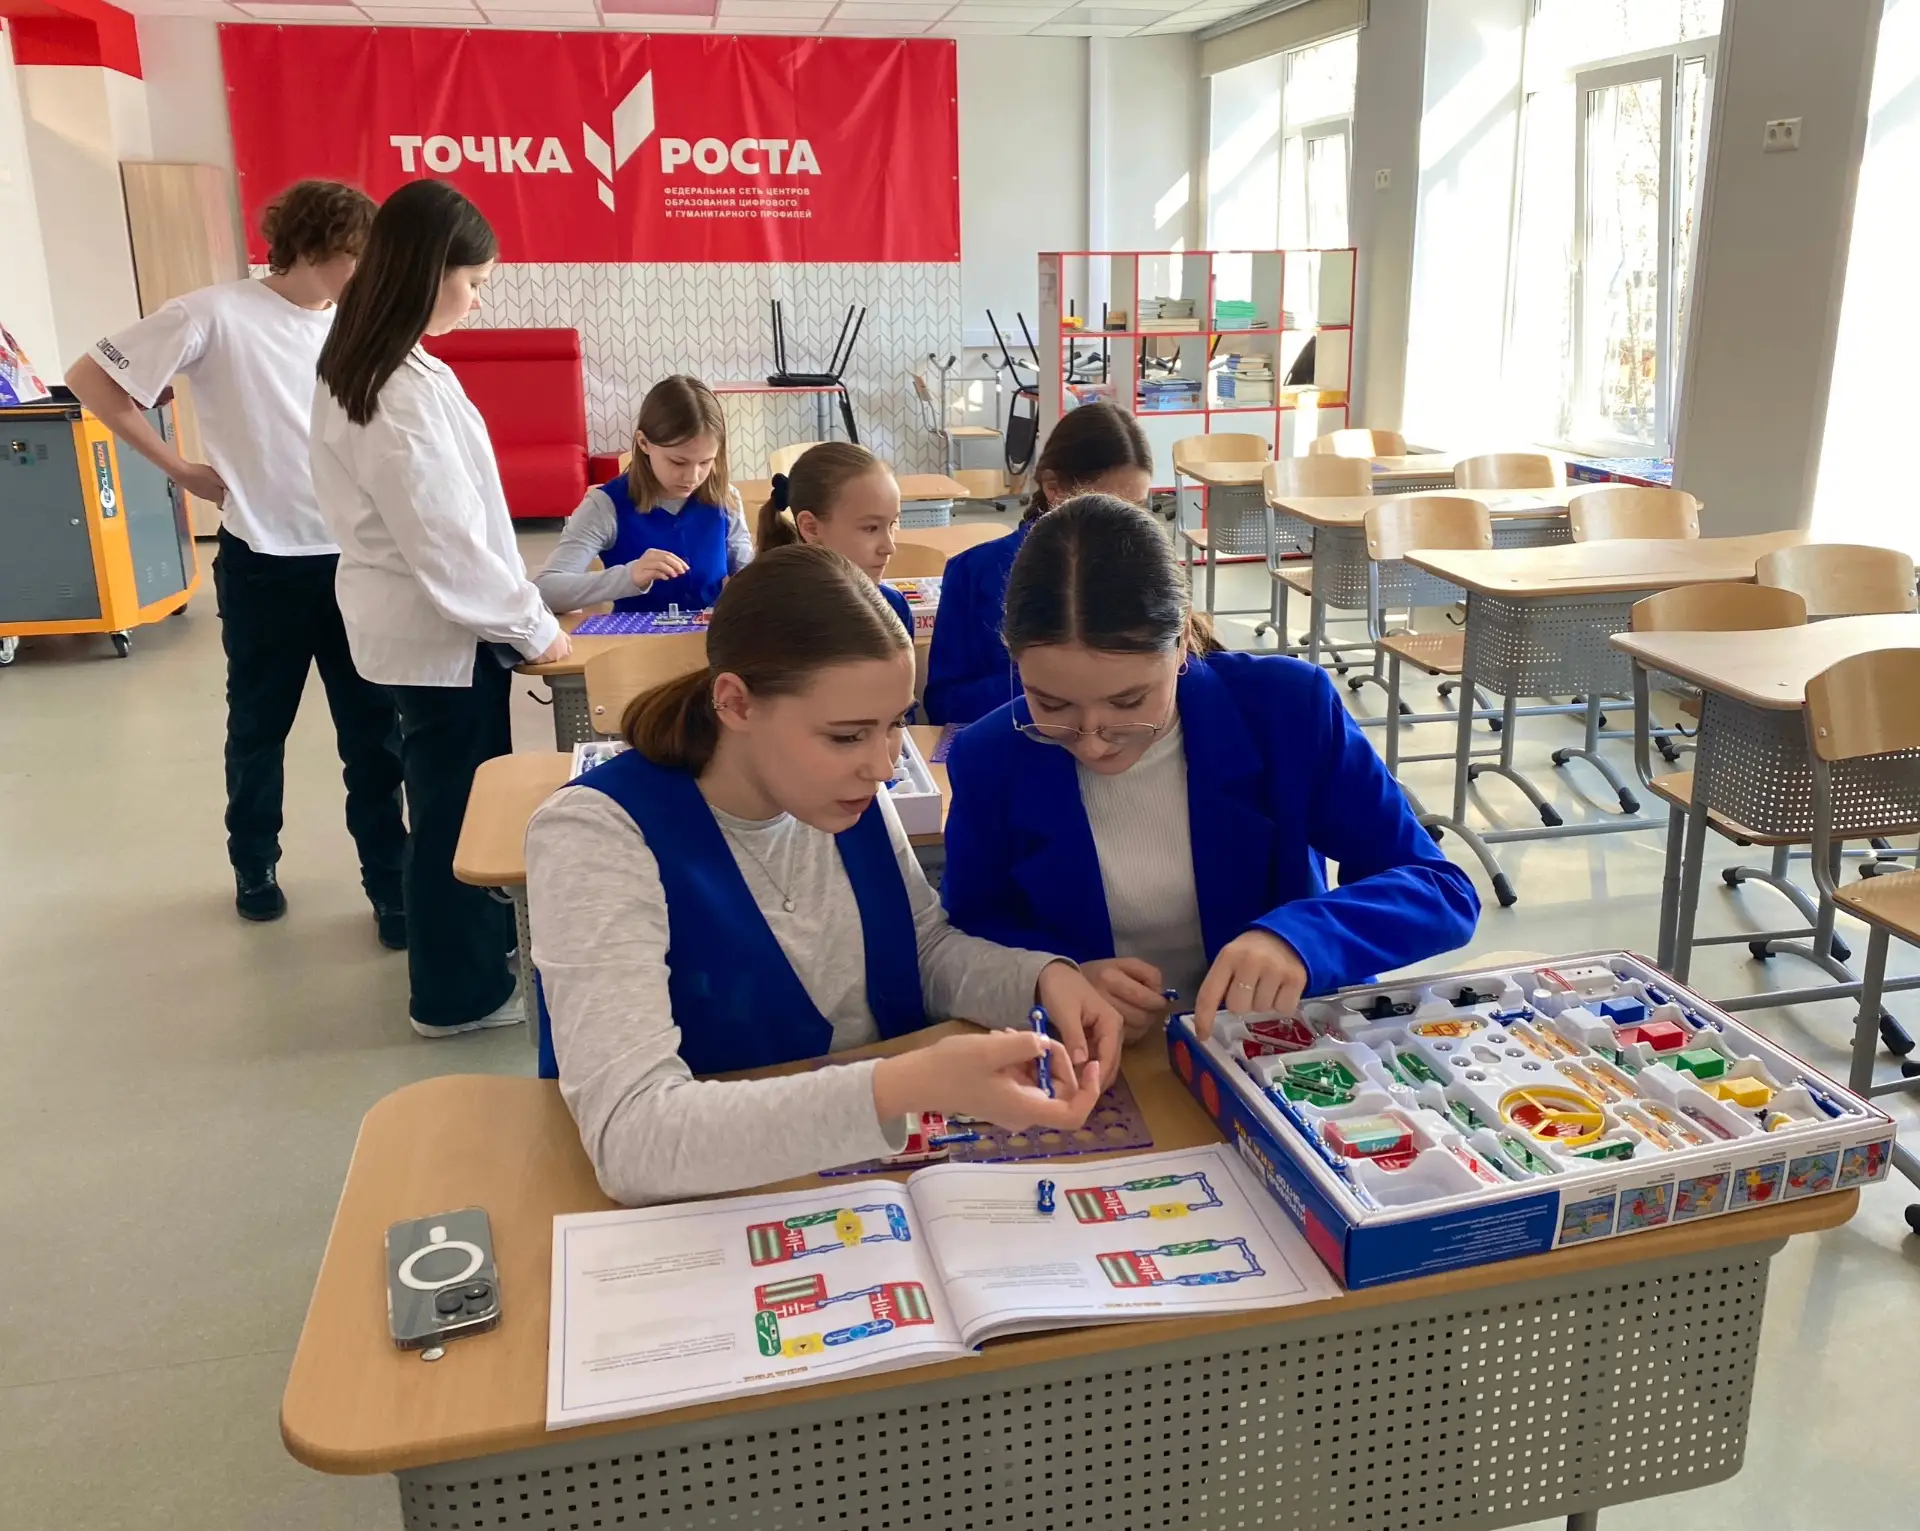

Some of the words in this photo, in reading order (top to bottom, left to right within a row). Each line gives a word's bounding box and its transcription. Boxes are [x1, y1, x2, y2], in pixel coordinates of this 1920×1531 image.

[390, 135, 573, 173] ТОЧКА
[660, 138, 822, 175] РОСТА
[664, 187, 736, 196] ФЕДЕРАЛЬНАЯ
[738, 187, 764, 196] СЕТЬ
[766, 187, 811, 196] ЦЕНТРОВ
[664, 198, 736, 207] ОБРАЗОВАНИЯ
[738, 198, 798, 208] ЦИФРОВОГО
[665, 210, 673, 218] И
[675, 210, 757, 218] ГУМАНИТАРНОГО
[760, 209, 812, 219] ПРОФИЛЕЙ
[916, 615, 935, 628] СХЕ
